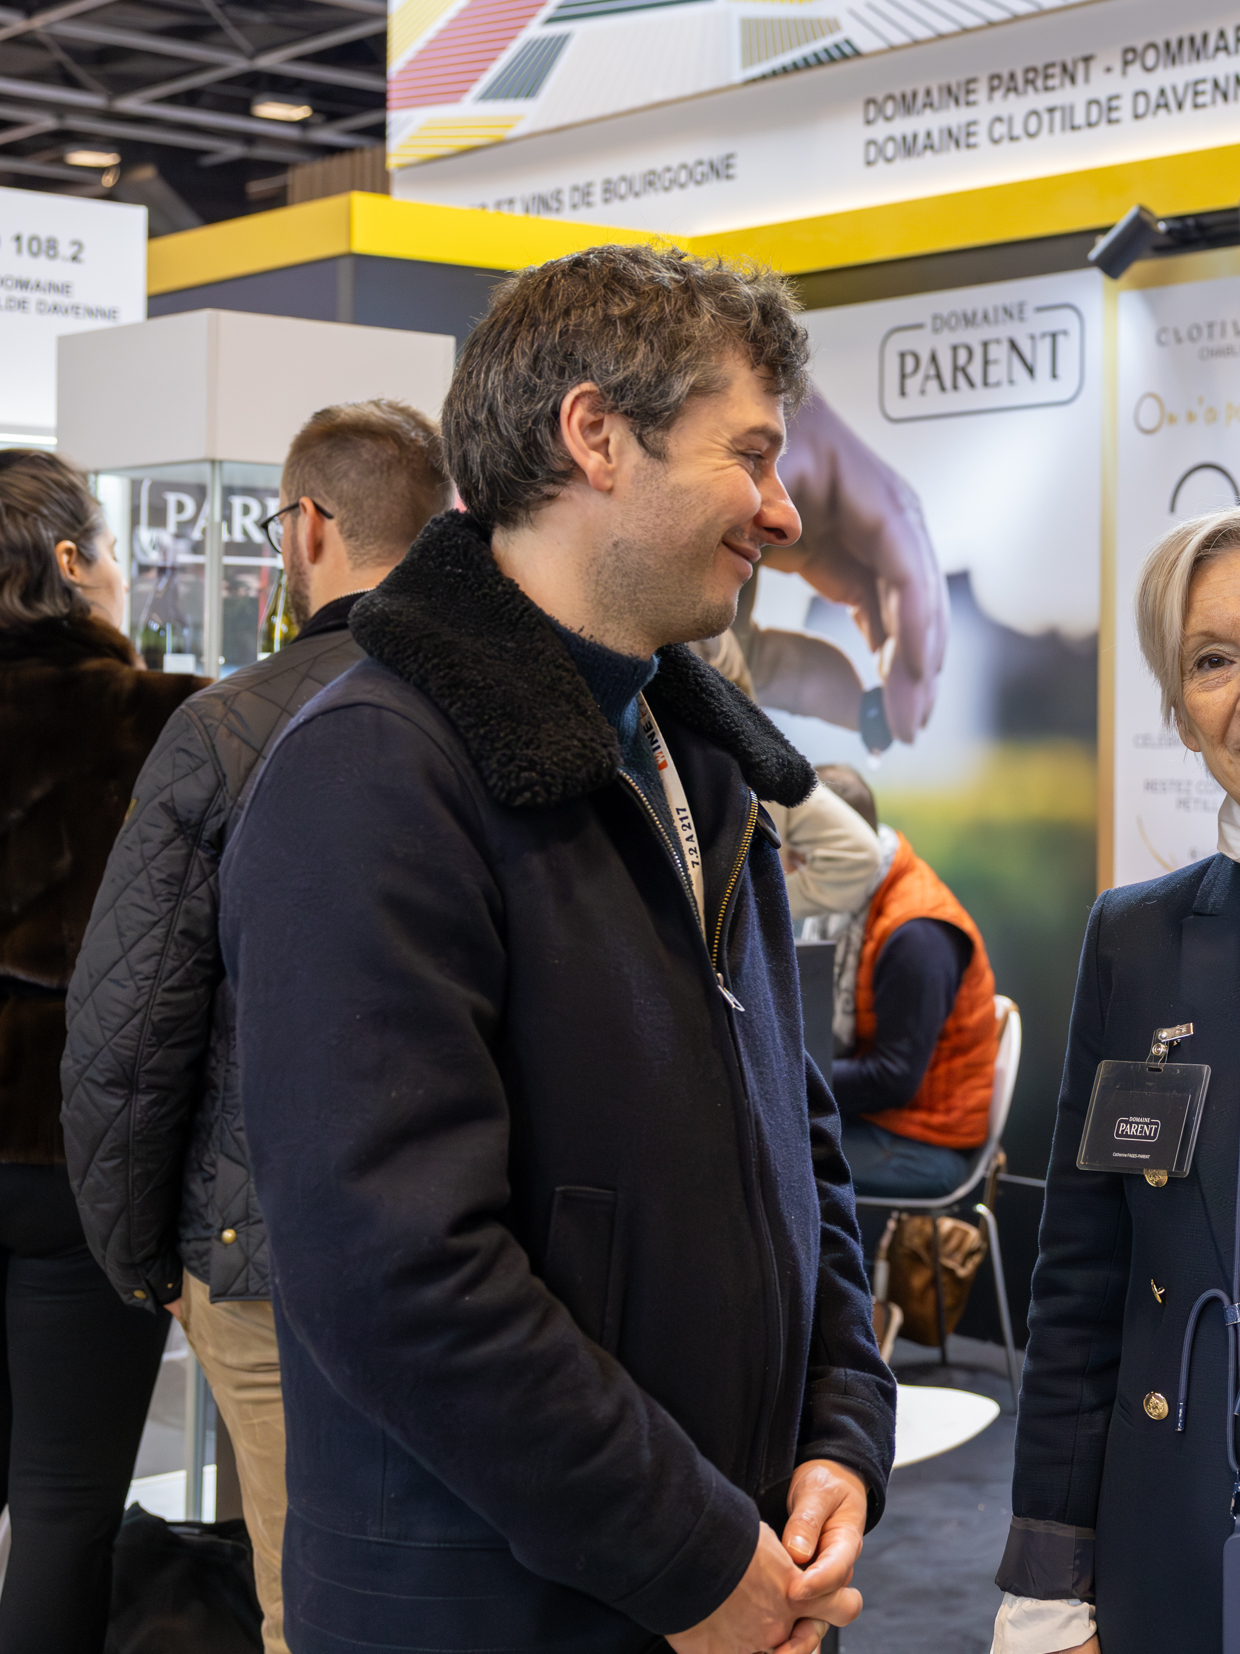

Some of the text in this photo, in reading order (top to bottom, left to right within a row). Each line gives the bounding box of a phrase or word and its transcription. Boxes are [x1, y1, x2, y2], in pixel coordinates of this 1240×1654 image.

[864, 77, 979, 126] DOMAINE
[987, 54, 1096, 102] PARENT
[864, 120, 979, 167] DOMAINE
[988, 94, 1121, 146] CLOTILDE
[523, 190, 565, 217] VINS
[569, 182, 597, 210] DE
[600, 153, 737, 203] BOURGOGNE
[12, 233, 84, 264] 108.2
[35, 298, 119, 322] DAVENNE
[931, 300, 1029, 335] DOMAINE
[897, 329, 1069, 398] PARENT
[675, 807, 700, 868] 7.2 A 217
[1118, 1122, 1158, 1137] PARENT
